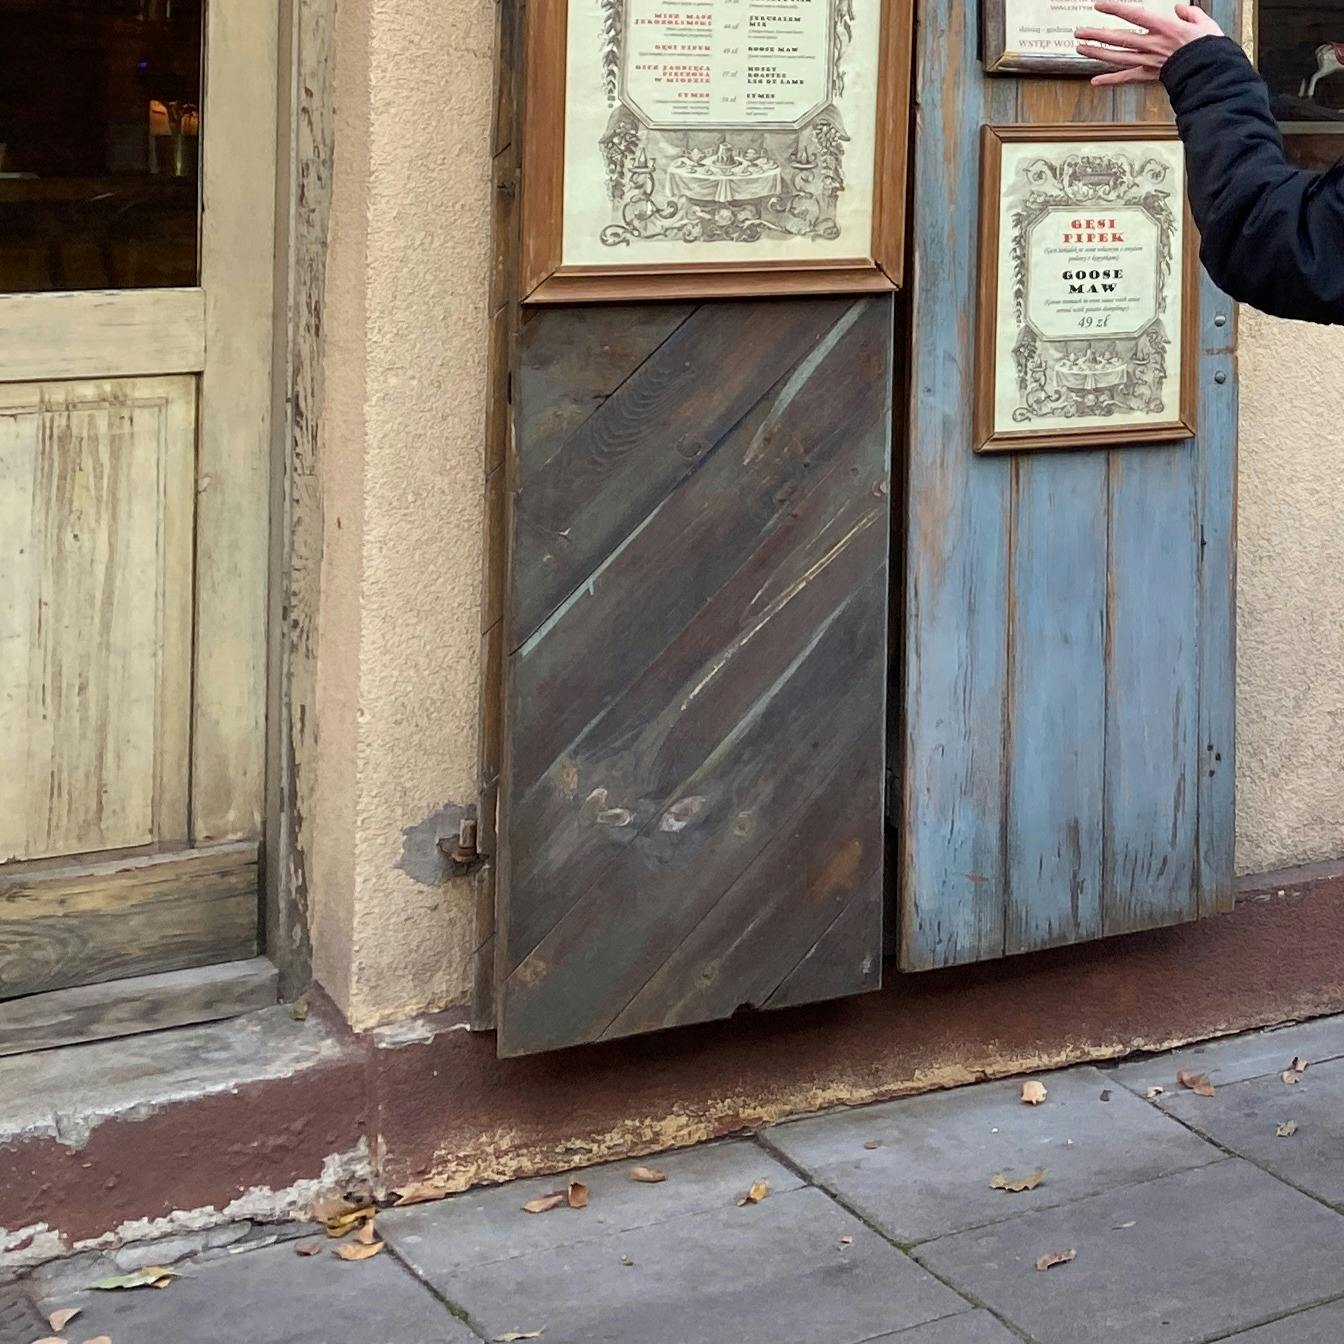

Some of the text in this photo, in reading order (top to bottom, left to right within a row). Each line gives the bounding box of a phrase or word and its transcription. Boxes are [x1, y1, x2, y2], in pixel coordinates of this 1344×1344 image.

[1070, 218, 1116, 230] GĘSI
[1062, 231, 1125, 244] PIPEK
[1061, 269, 1124, 280] GOOSE
[1068, 282, 1118, 294] MAW
[1077, 313, 1111, 328] 49 zł
